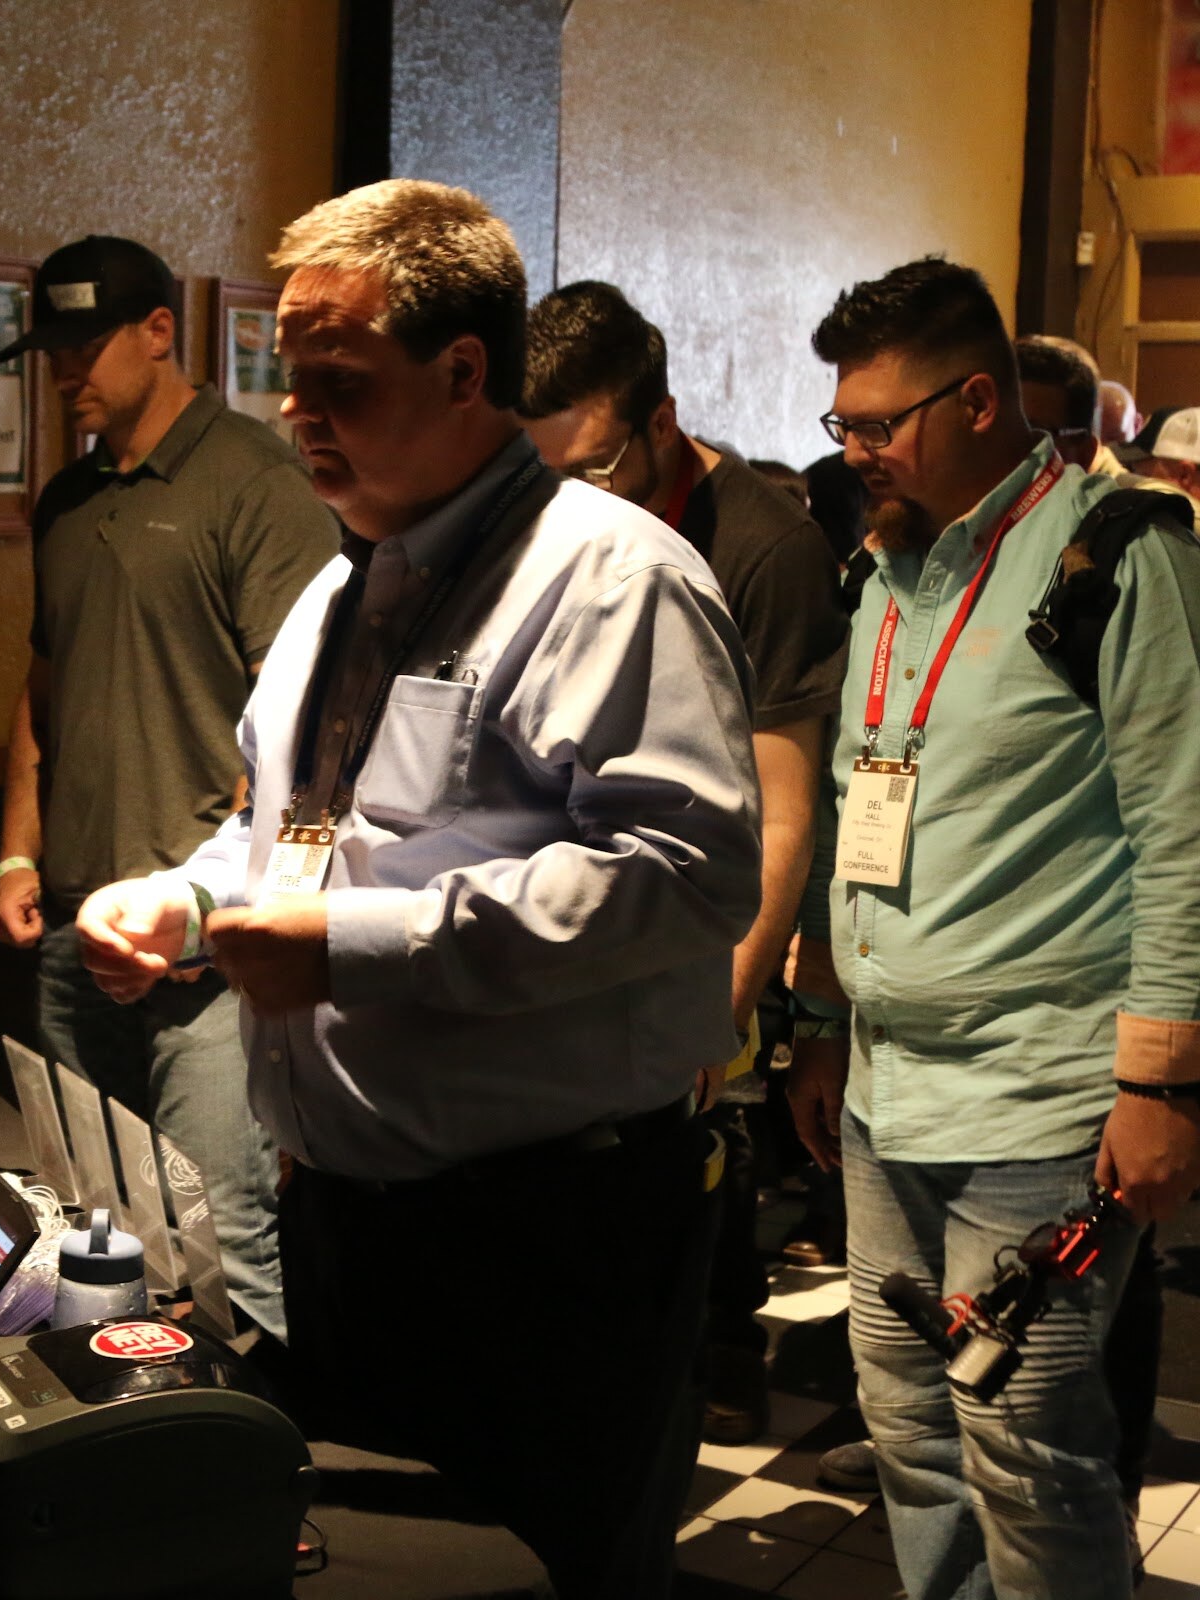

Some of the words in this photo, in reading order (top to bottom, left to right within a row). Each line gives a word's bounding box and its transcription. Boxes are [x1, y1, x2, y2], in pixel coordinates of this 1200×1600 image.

[1010, 471, 1054, 520] BREWERS
[872, 619, 893, 696] ASSOCIATION
[867, 800, 884, 811] DEL
[865, 813, 881, 821] HALL
[857, 850, 875, 861] FULL
[843, 860, 889, 874] CONFERENCE
[101, 1328, 155, 1355] NET
[131, 1325, 183, 1348] BEV
